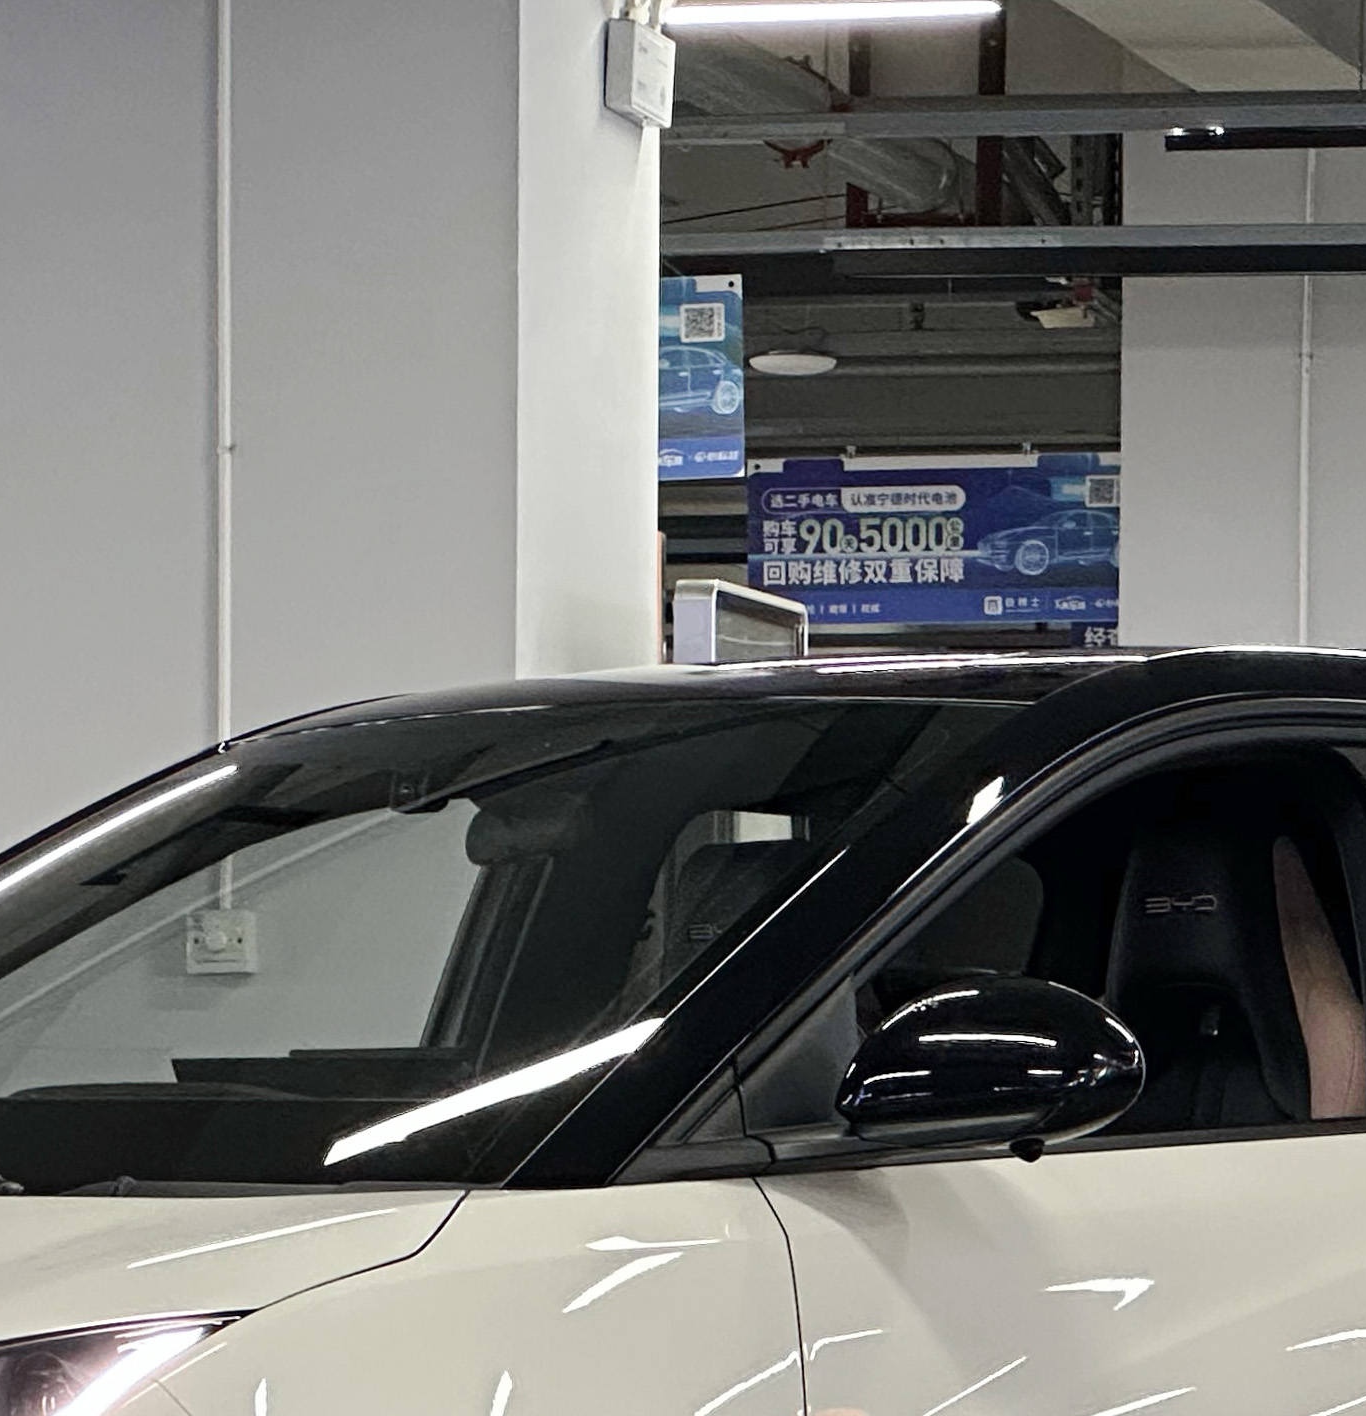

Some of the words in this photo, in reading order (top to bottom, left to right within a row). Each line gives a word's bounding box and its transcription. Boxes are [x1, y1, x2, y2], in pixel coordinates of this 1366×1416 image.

[770, 494, 838, 508] 选二手电车
[763, 558, 965, 586] 回购维修双重保障
[1145, 894, 1217, 915] BYD
